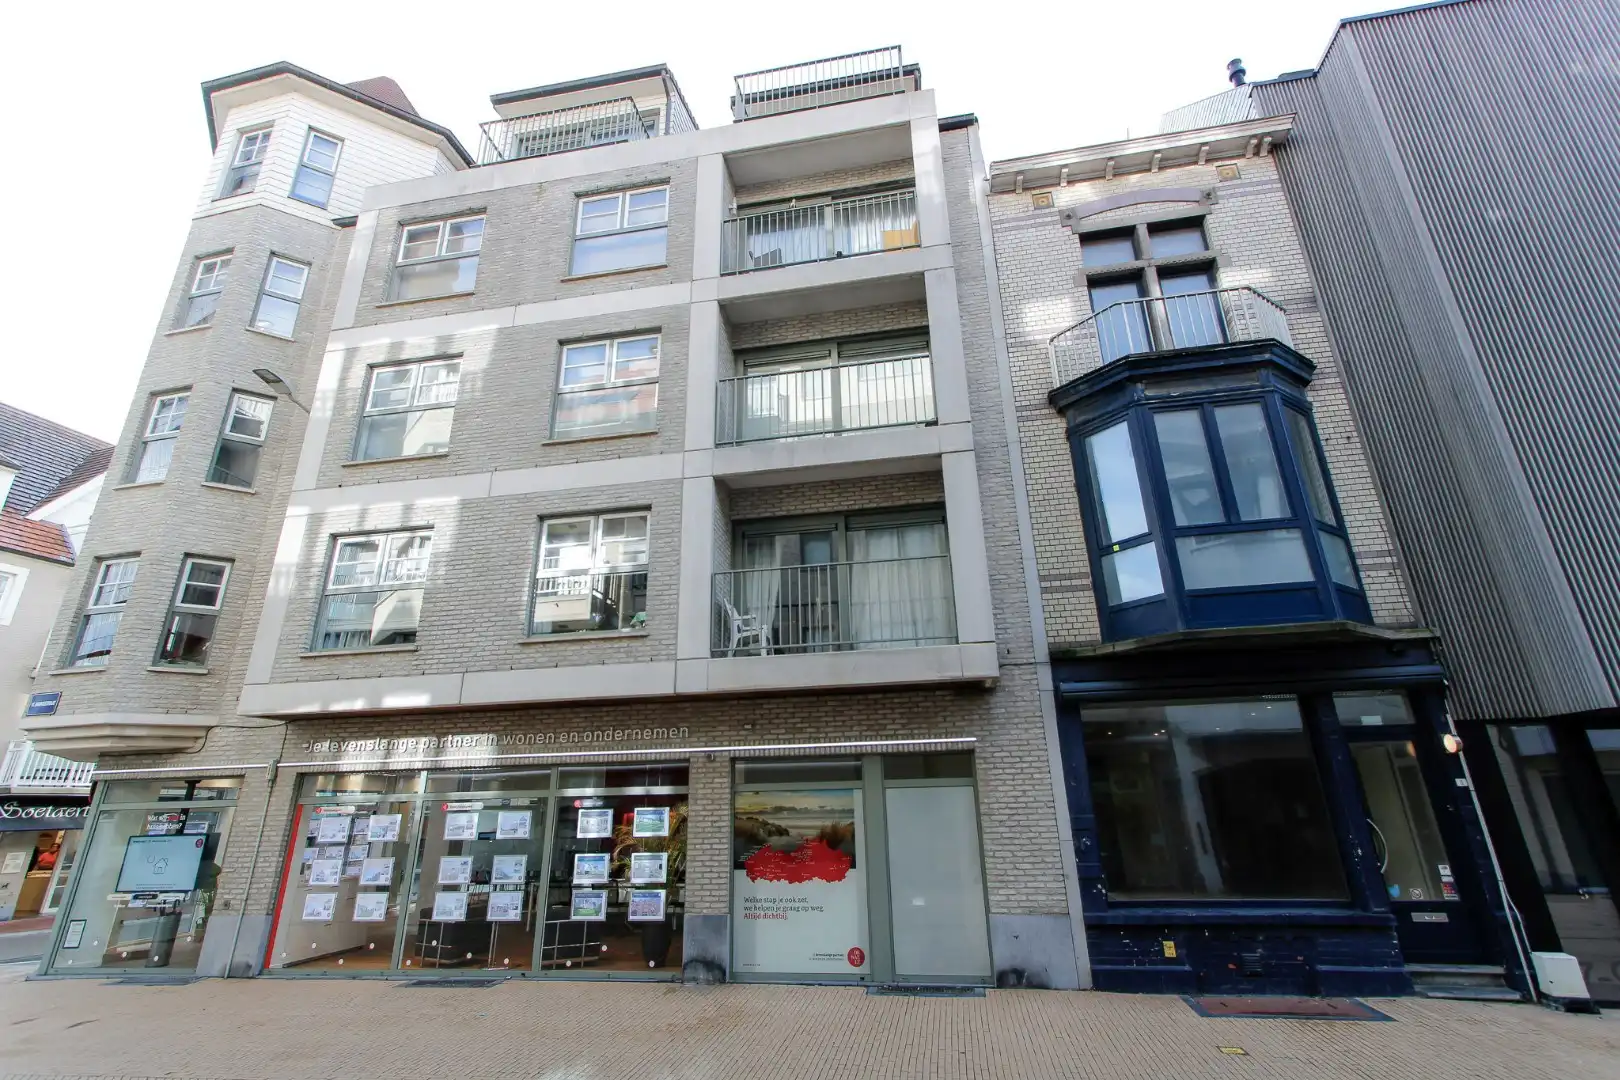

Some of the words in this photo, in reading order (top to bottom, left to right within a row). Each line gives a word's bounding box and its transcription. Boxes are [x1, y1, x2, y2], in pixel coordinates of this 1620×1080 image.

[302, 739, 321, 753] Je
[325, 736, 418, 754] levenslange
[421, 733, 482, 751] partner
[484, 733, 498, 747] in
[503, 732, 555, 745] wonen
[559, 730, 579, 743] en
[583, 726, 689, 742] ondernemen
[743, 896, 763, 904] Welke
[763, 896, 777, 905] stap
[753, 905, 775, 913] helpen
[743, 912, 761, 920] Altijd
